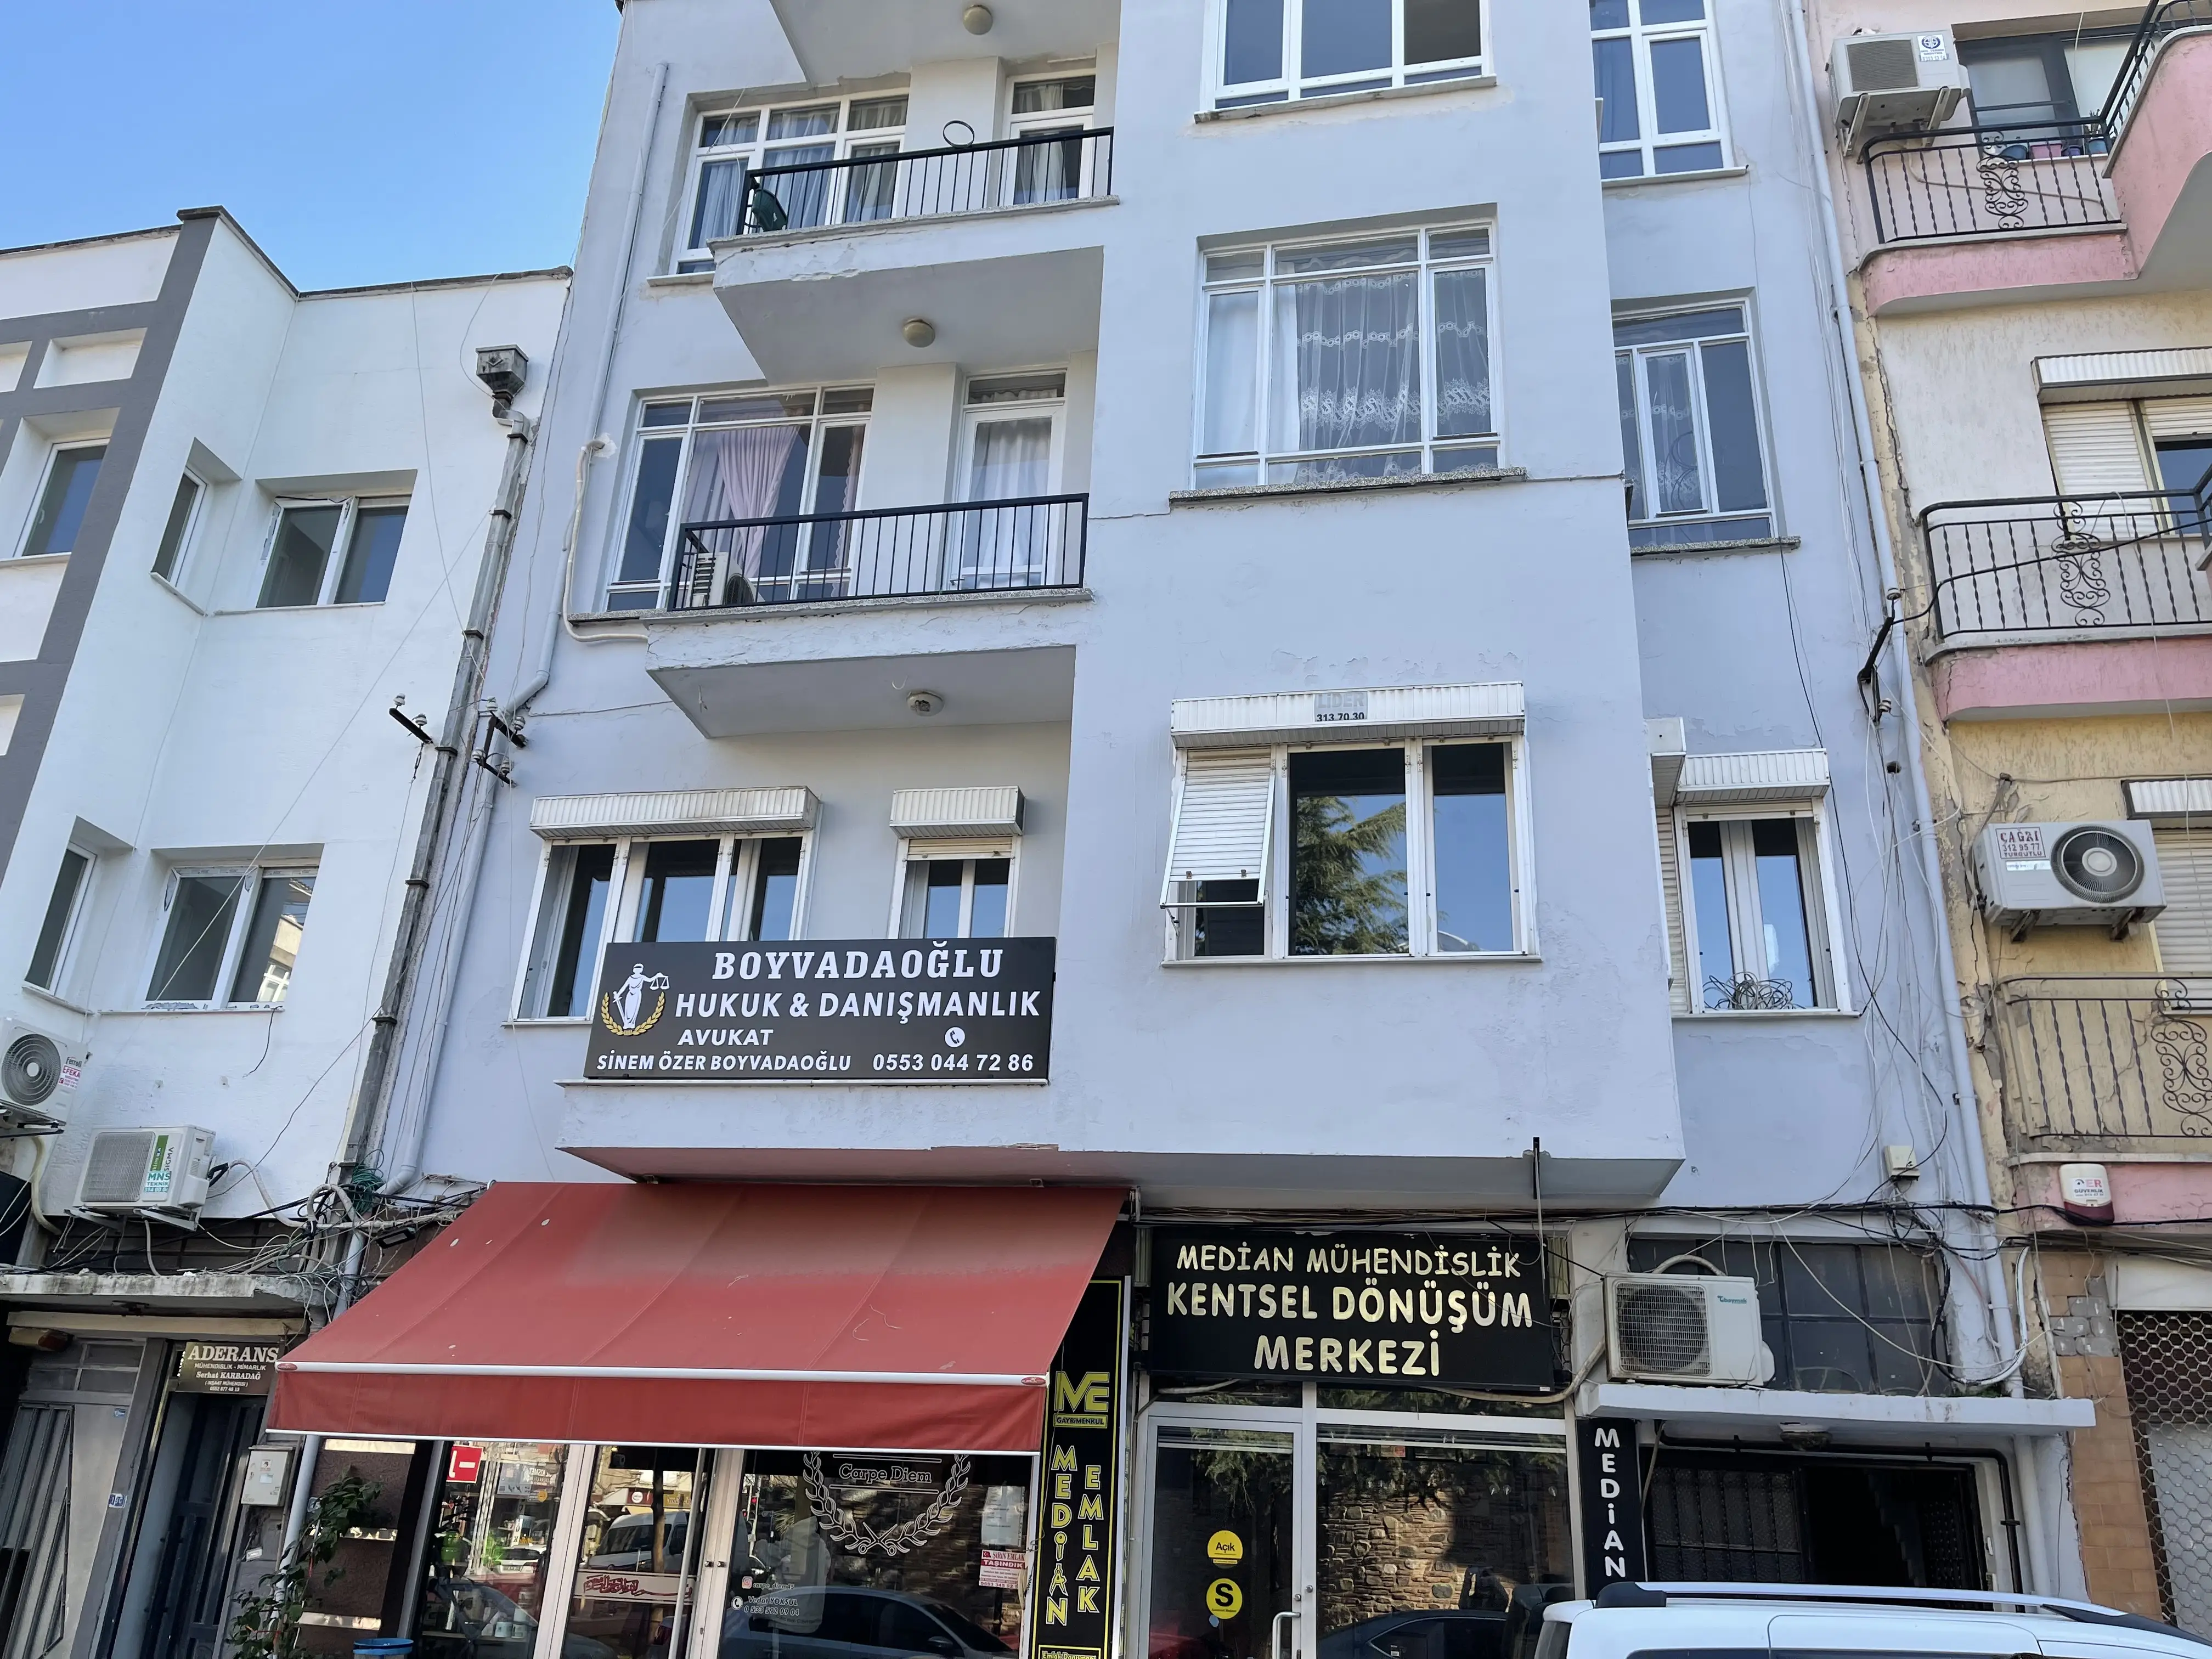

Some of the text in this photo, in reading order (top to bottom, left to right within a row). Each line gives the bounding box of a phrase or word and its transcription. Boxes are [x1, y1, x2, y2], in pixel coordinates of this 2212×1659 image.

[1317, 713, 1334, 721] 313
[1338, 713, 1350, 721] 70
[712, 940, 1003, 980] BOYVADAOĞLU
[675, 991, 1040, 1024] HUKUK & DANIŞMANLIK
[677, 1029, 774, 1046] AVUKAT
[597, 1049, 851, 1071] SİNEM ÖZER BOYVADAOĞLU
[873, 1054, 1034, 1071] 0553 044 72 86
[2086, 1179, 2102, 1187] ER
[1177, 1242, 1521, 1278] MEDİAN MÜHENDİSLİK
[1167, 1277, 1533, 1333] KENTSEL DÖNÜŞÜM
[188, 1346, 279, 1363] ADERANS
[1254, 1329, 1440, 1376] MERKEZİ
[220, 1372, 261, 1380] KARBADAĞ
[839, 1463, 932, 1484] Carpe Diem
[1076, 1465, 1104, 1613] EMLAK
[1215, 1542, 1235, 1553] Açık
[770, 1598, 798, 1606] YOKSUL
[1215, 1583, 1234, 1607] S
